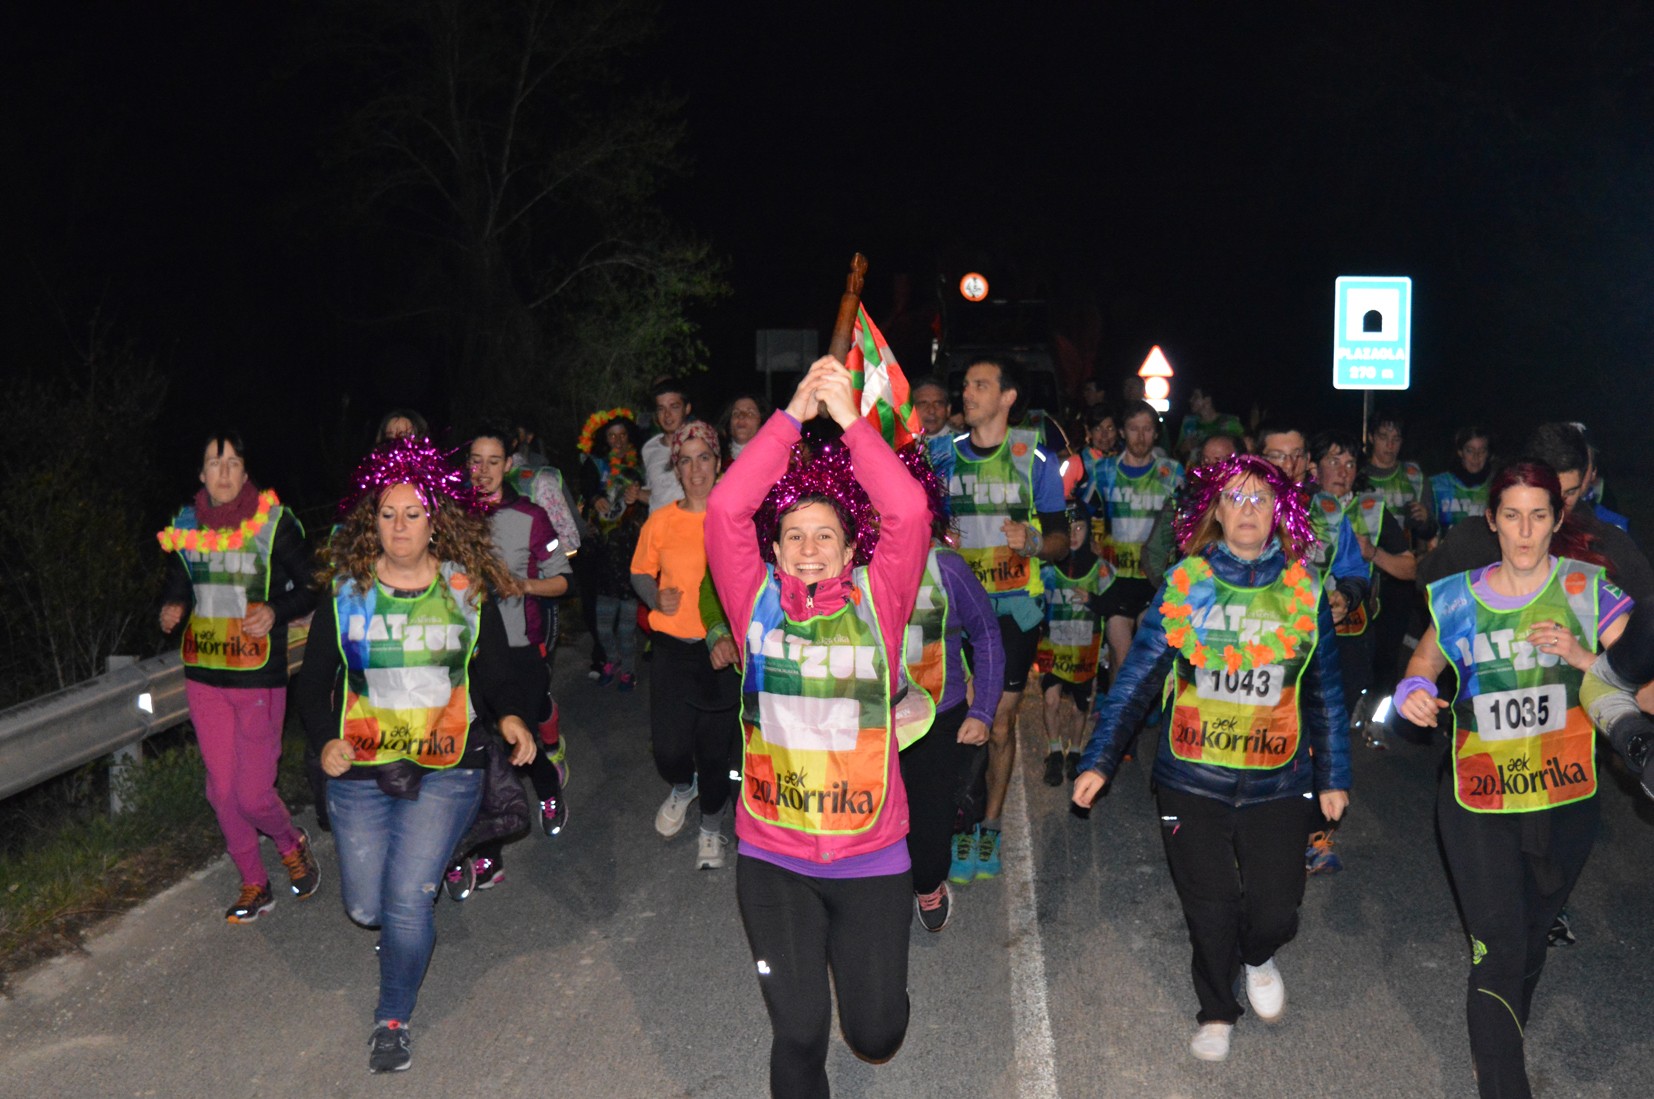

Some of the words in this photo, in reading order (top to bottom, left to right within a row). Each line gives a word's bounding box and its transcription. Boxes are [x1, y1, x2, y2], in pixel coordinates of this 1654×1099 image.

[348, 614, 408, 641] BAT
[403, 624, 467, 651] ZUK
[801, 645, 878, 680] ZUK
[1211, 670, 1271, 698] 1043
[1489, 695, 1550, 731] 1035
